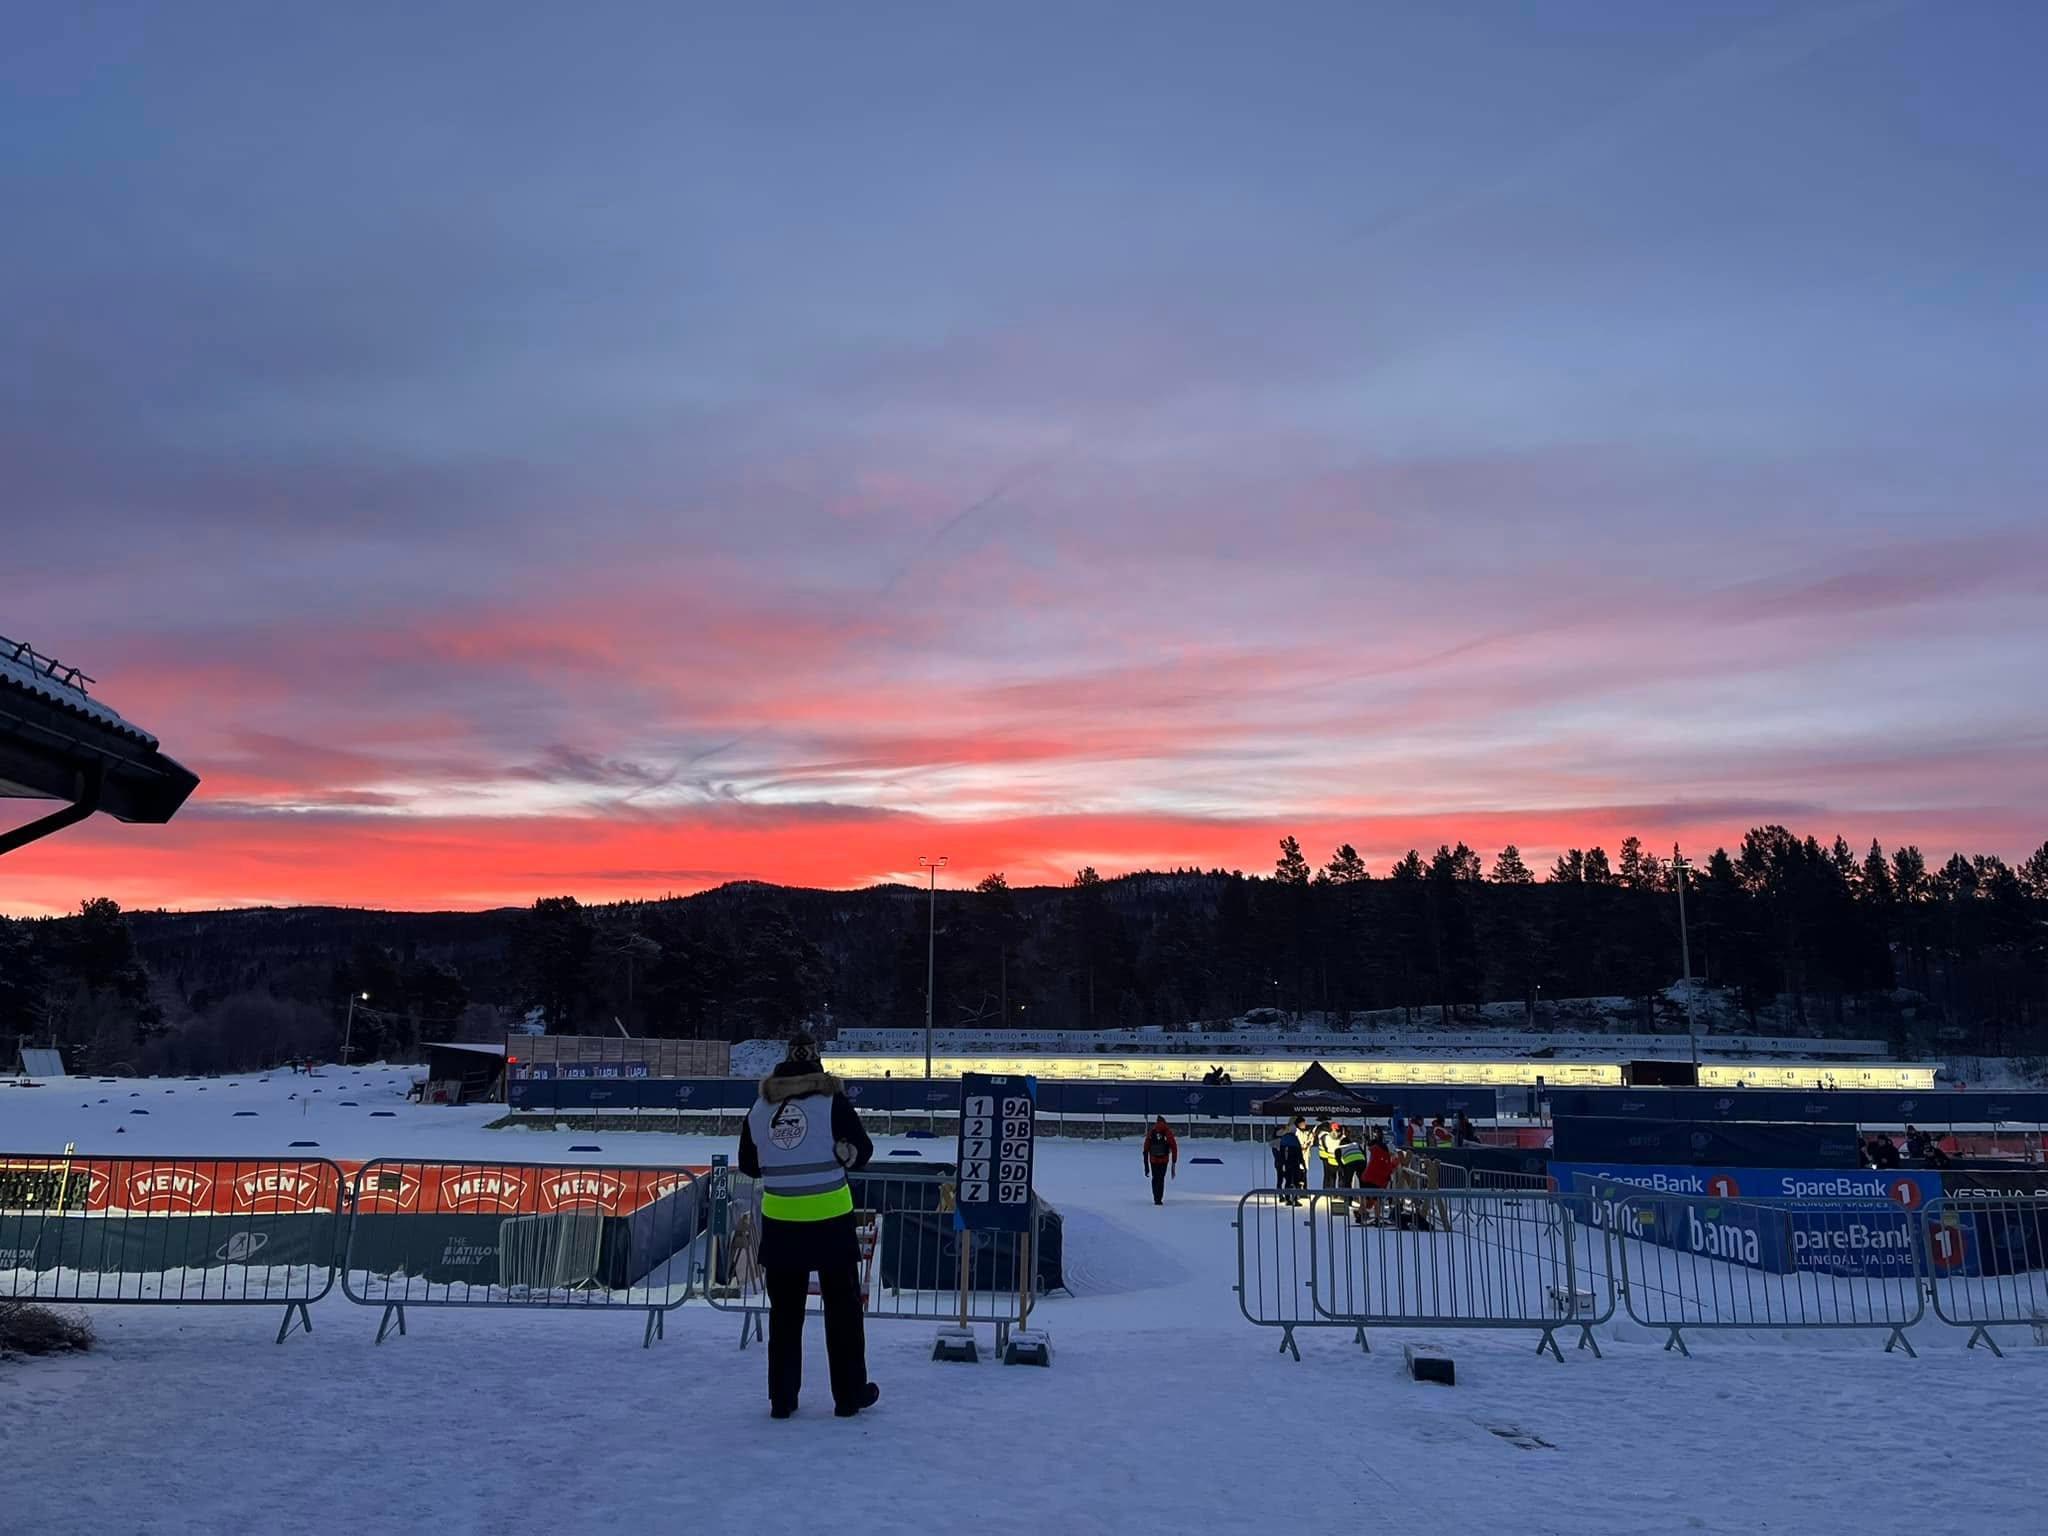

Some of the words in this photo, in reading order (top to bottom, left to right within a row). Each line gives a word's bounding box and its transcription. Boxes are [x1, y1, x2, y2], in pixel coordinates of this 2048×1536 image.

[630, 1067, 647, 1077] LAPUA
[974, 1099, 984, 1115] 1
[1004, 1100, 1029, 1117] 9A
[1293, 1104, 1362, 1114] www.vossgeilo.no
[971, 1120, 983, 1136] 2
[1005, 1121, 1029, 1138] 9B
[971, 1141, 983, 1157] 7
[1002, 1142, 1027, 1159] 9C
[967, 1162, 982, 1178] X
[1001, 1164, 1026, 1181] 9D
[136, 1175, 202, 1196] MENY
[243, 1176, 311, 1196] MENY
[452, 1178, 517, 1198] MENY
[552, 1179, 617, 1199] MENY
[968, 1184, 982, 1201] Z
[1001, 1185, 1025, 1202] 9F
[1715, 1180, 1729, 1198] 1
[1781, 1177, 1886, 1199] SpareBank
[1897, 1183, 1911, 1205] 1
[447, 1236, 469, 1246] THE
[1689, 1205, 1759, 1265] bama
[1793, 1223, 1912, 1254] pareBank
[1935, 1230, 1953, 1260] 1
[441, 1255, 484, 1265] FAMILY
